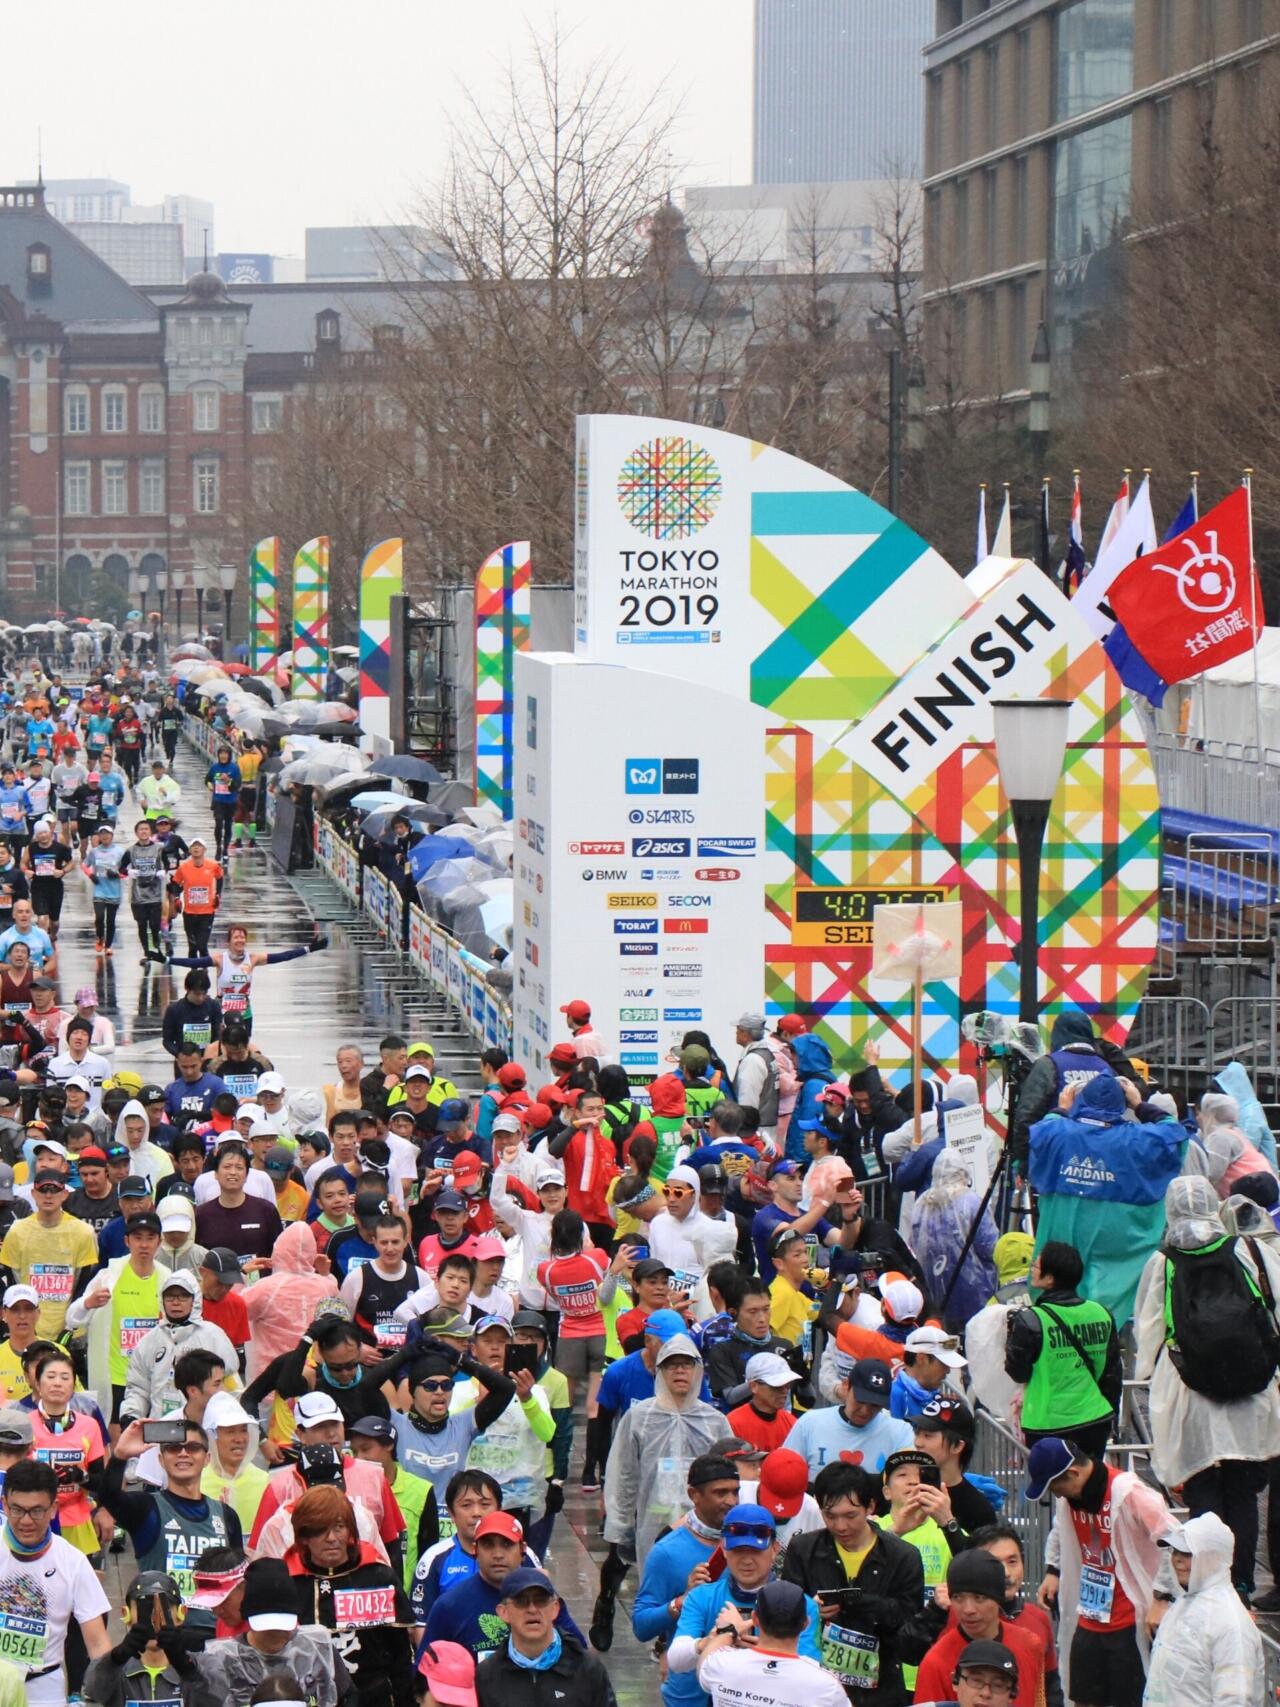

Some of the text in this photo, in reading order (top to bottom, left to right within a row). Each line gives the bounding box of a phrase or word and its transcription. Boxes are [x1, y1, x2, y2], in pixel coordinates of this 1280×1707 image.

[619, 550, 719, 571] TOKYO
[621, 576, 717, 589] MARATHON
[619, 595, 719, 626] 2019
[870, 593, 1056, 773] FINISH
[646, 810, 694, 823] STARTS
[582, 844, 623, 854] ヤマザキ
[652, 839, 685, 853] asics
[596, 870, 627, 880] BMW
[700, 870, 736, 879] 第一生命
[609, 896, 657, 906] SEIKO
[668, 896, 711, 906] SECOM
[825, 926, 873, 943] SEI
[1060, 1165, 1116, 1183] LANDAIR
[817, 1447, 826, 1466] I
[336, 1593, 387, 1617] E70432
[7, 1618, 45, 1634] 東京メトロ
[841, 1633, 875, 1648] 東京メトロ
[718, 1685, 775, 1706] Camp Korey
